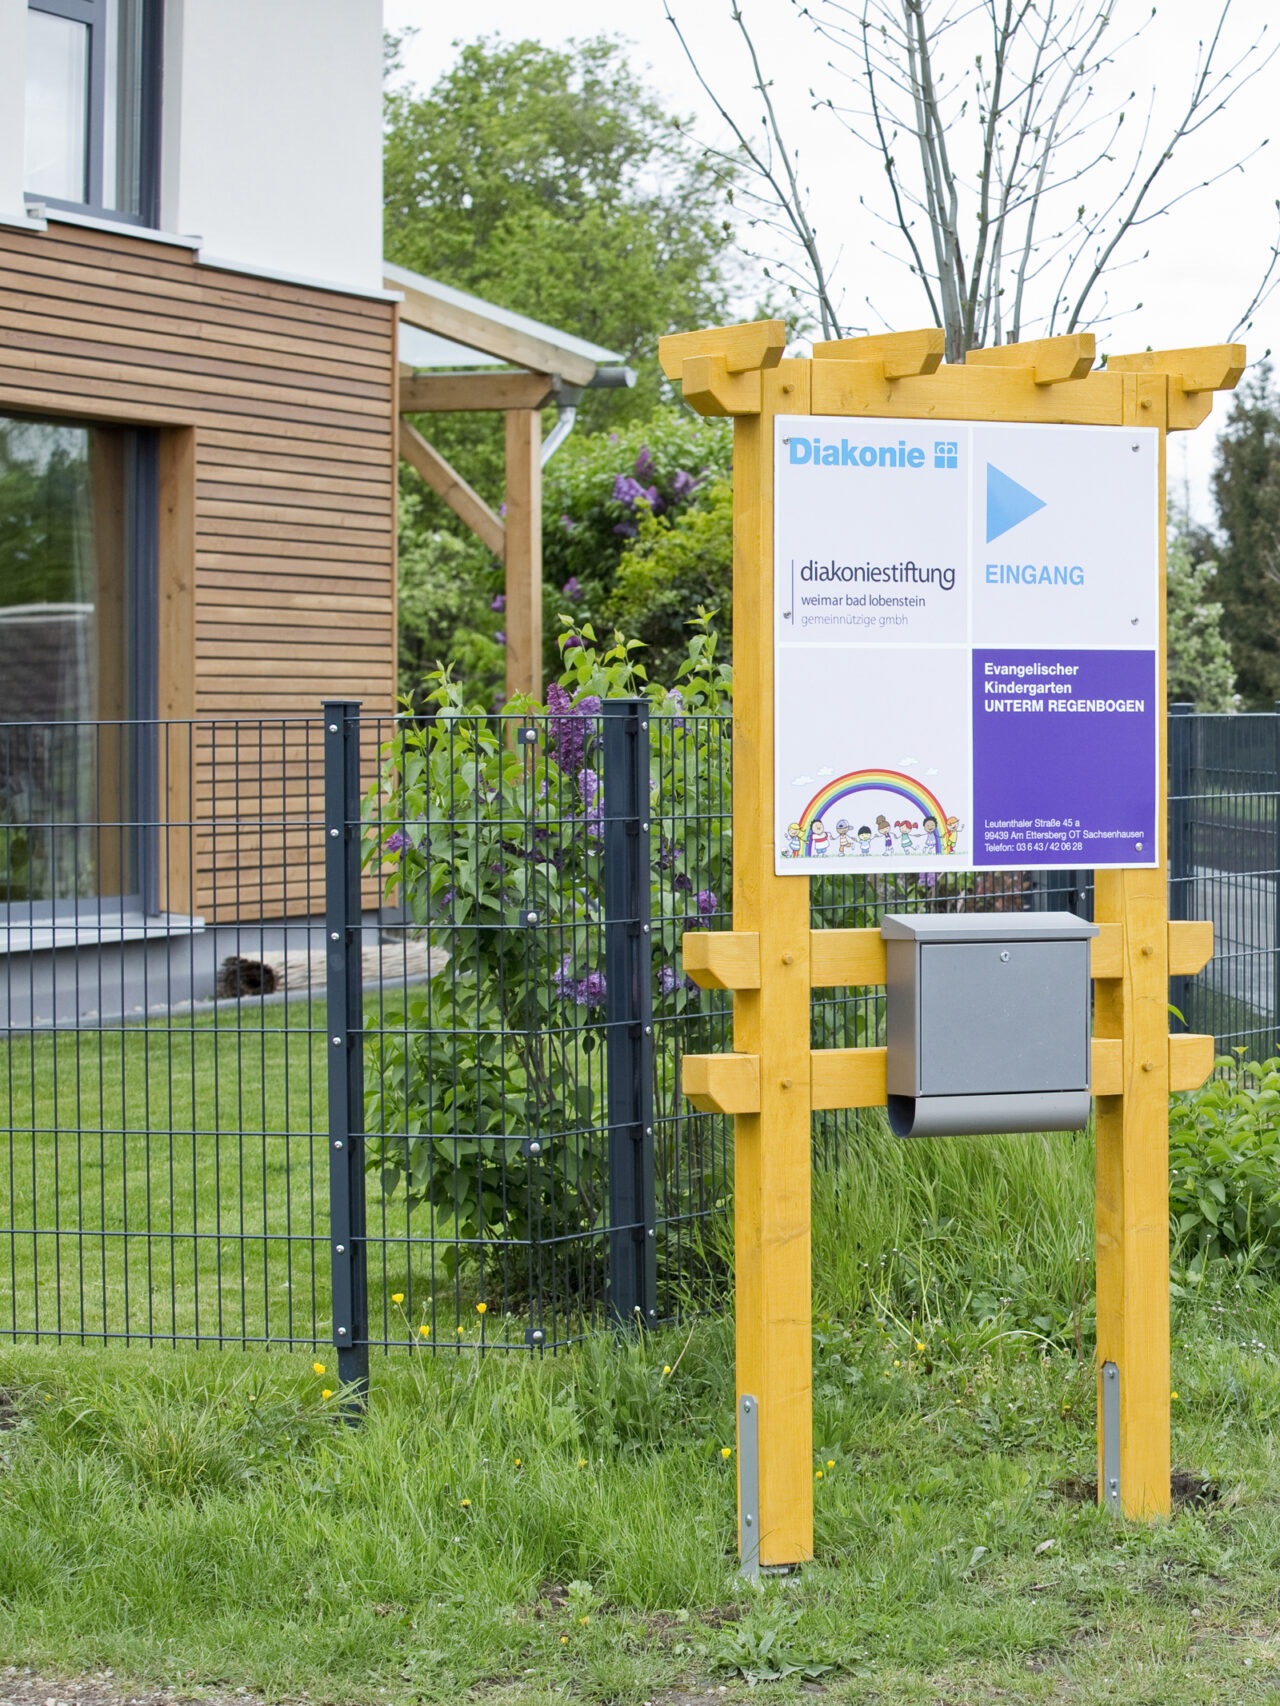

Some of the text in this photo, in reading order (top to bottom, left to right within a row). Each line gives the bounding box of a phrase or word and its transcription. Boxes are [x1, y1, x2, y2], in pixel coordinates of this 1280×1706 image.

[788, 437, 925, 468] Diakonie
[800, 560, 956, 591] diakoniestiftung
[985, 564, 1085, 586] EINGANG
[801, 594, 926, 607] weimar bad lobenstein
[801, 612, 909, 629] gemeinnützige gmbh
[985, 662, 1079, 678] Evangelischer
[984, 680, 1072, 697] Kindergarten
[984, 699, 1145, 713] UNTERM REGENBOGEN
[984, 818, 1081, 829] Leutenthaler Straße 45 a
[984, 830, 1145, 841] 99439 Am Ettersberg OT Sachsenhausen
[984, 843, 1015, 852] Telefon:
